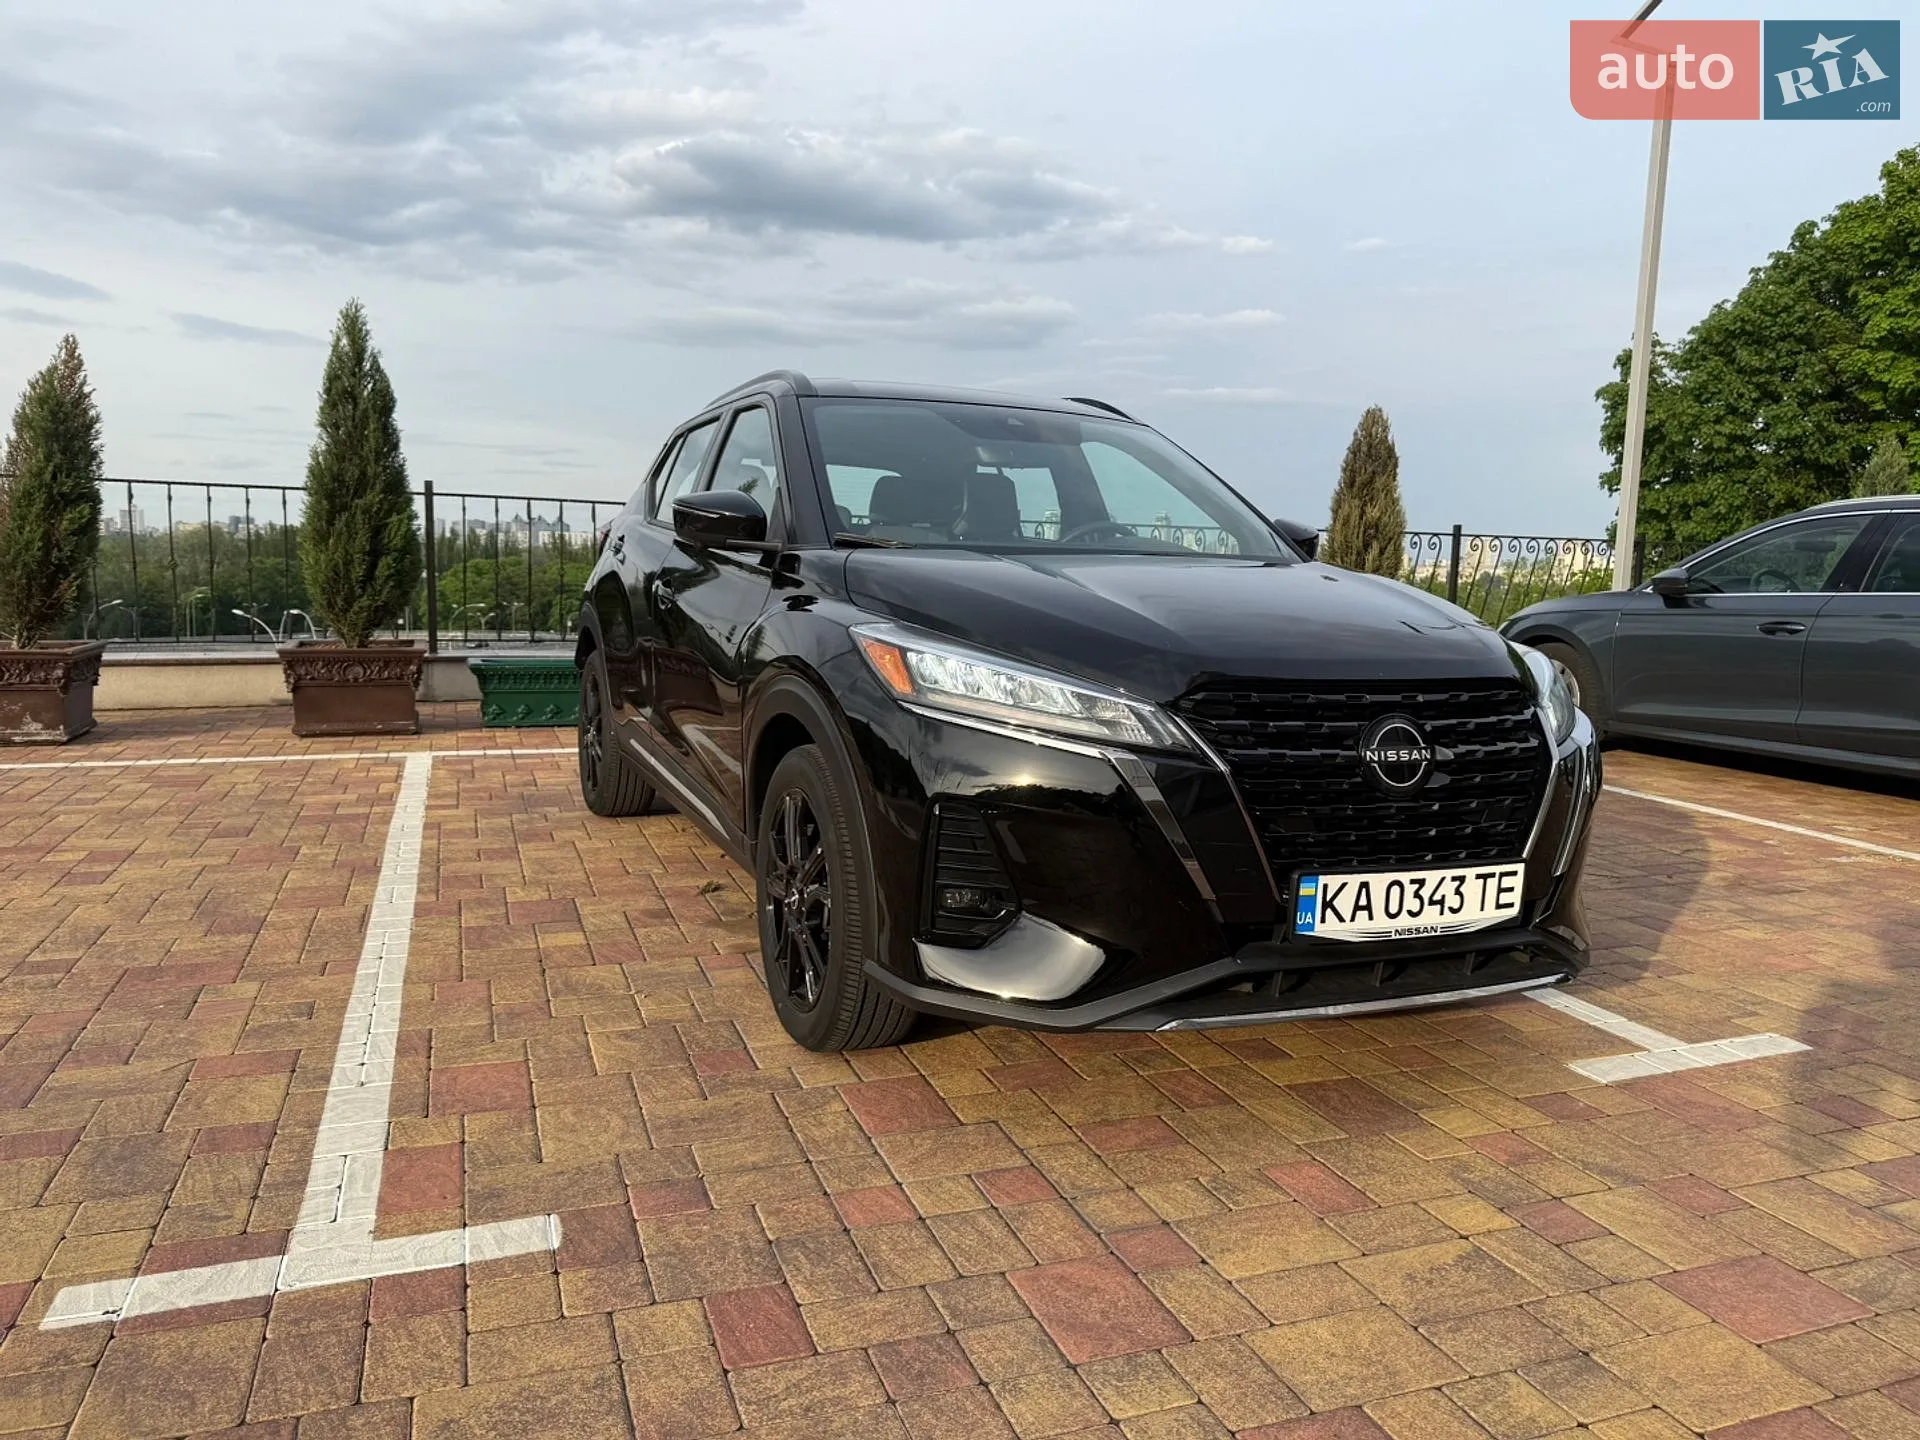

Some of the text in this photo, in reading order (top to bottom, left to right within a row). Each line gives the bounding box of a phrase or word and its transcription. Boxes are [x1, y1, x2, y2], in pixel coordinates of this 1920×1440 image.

[1366, 749, 1431, 761] NISSAN
[1319, 870, 1519, 924] KA 0343 TE
[1296, 912, 1313, 925] UA
[1394, 925, 1439, 937] NISSAN
